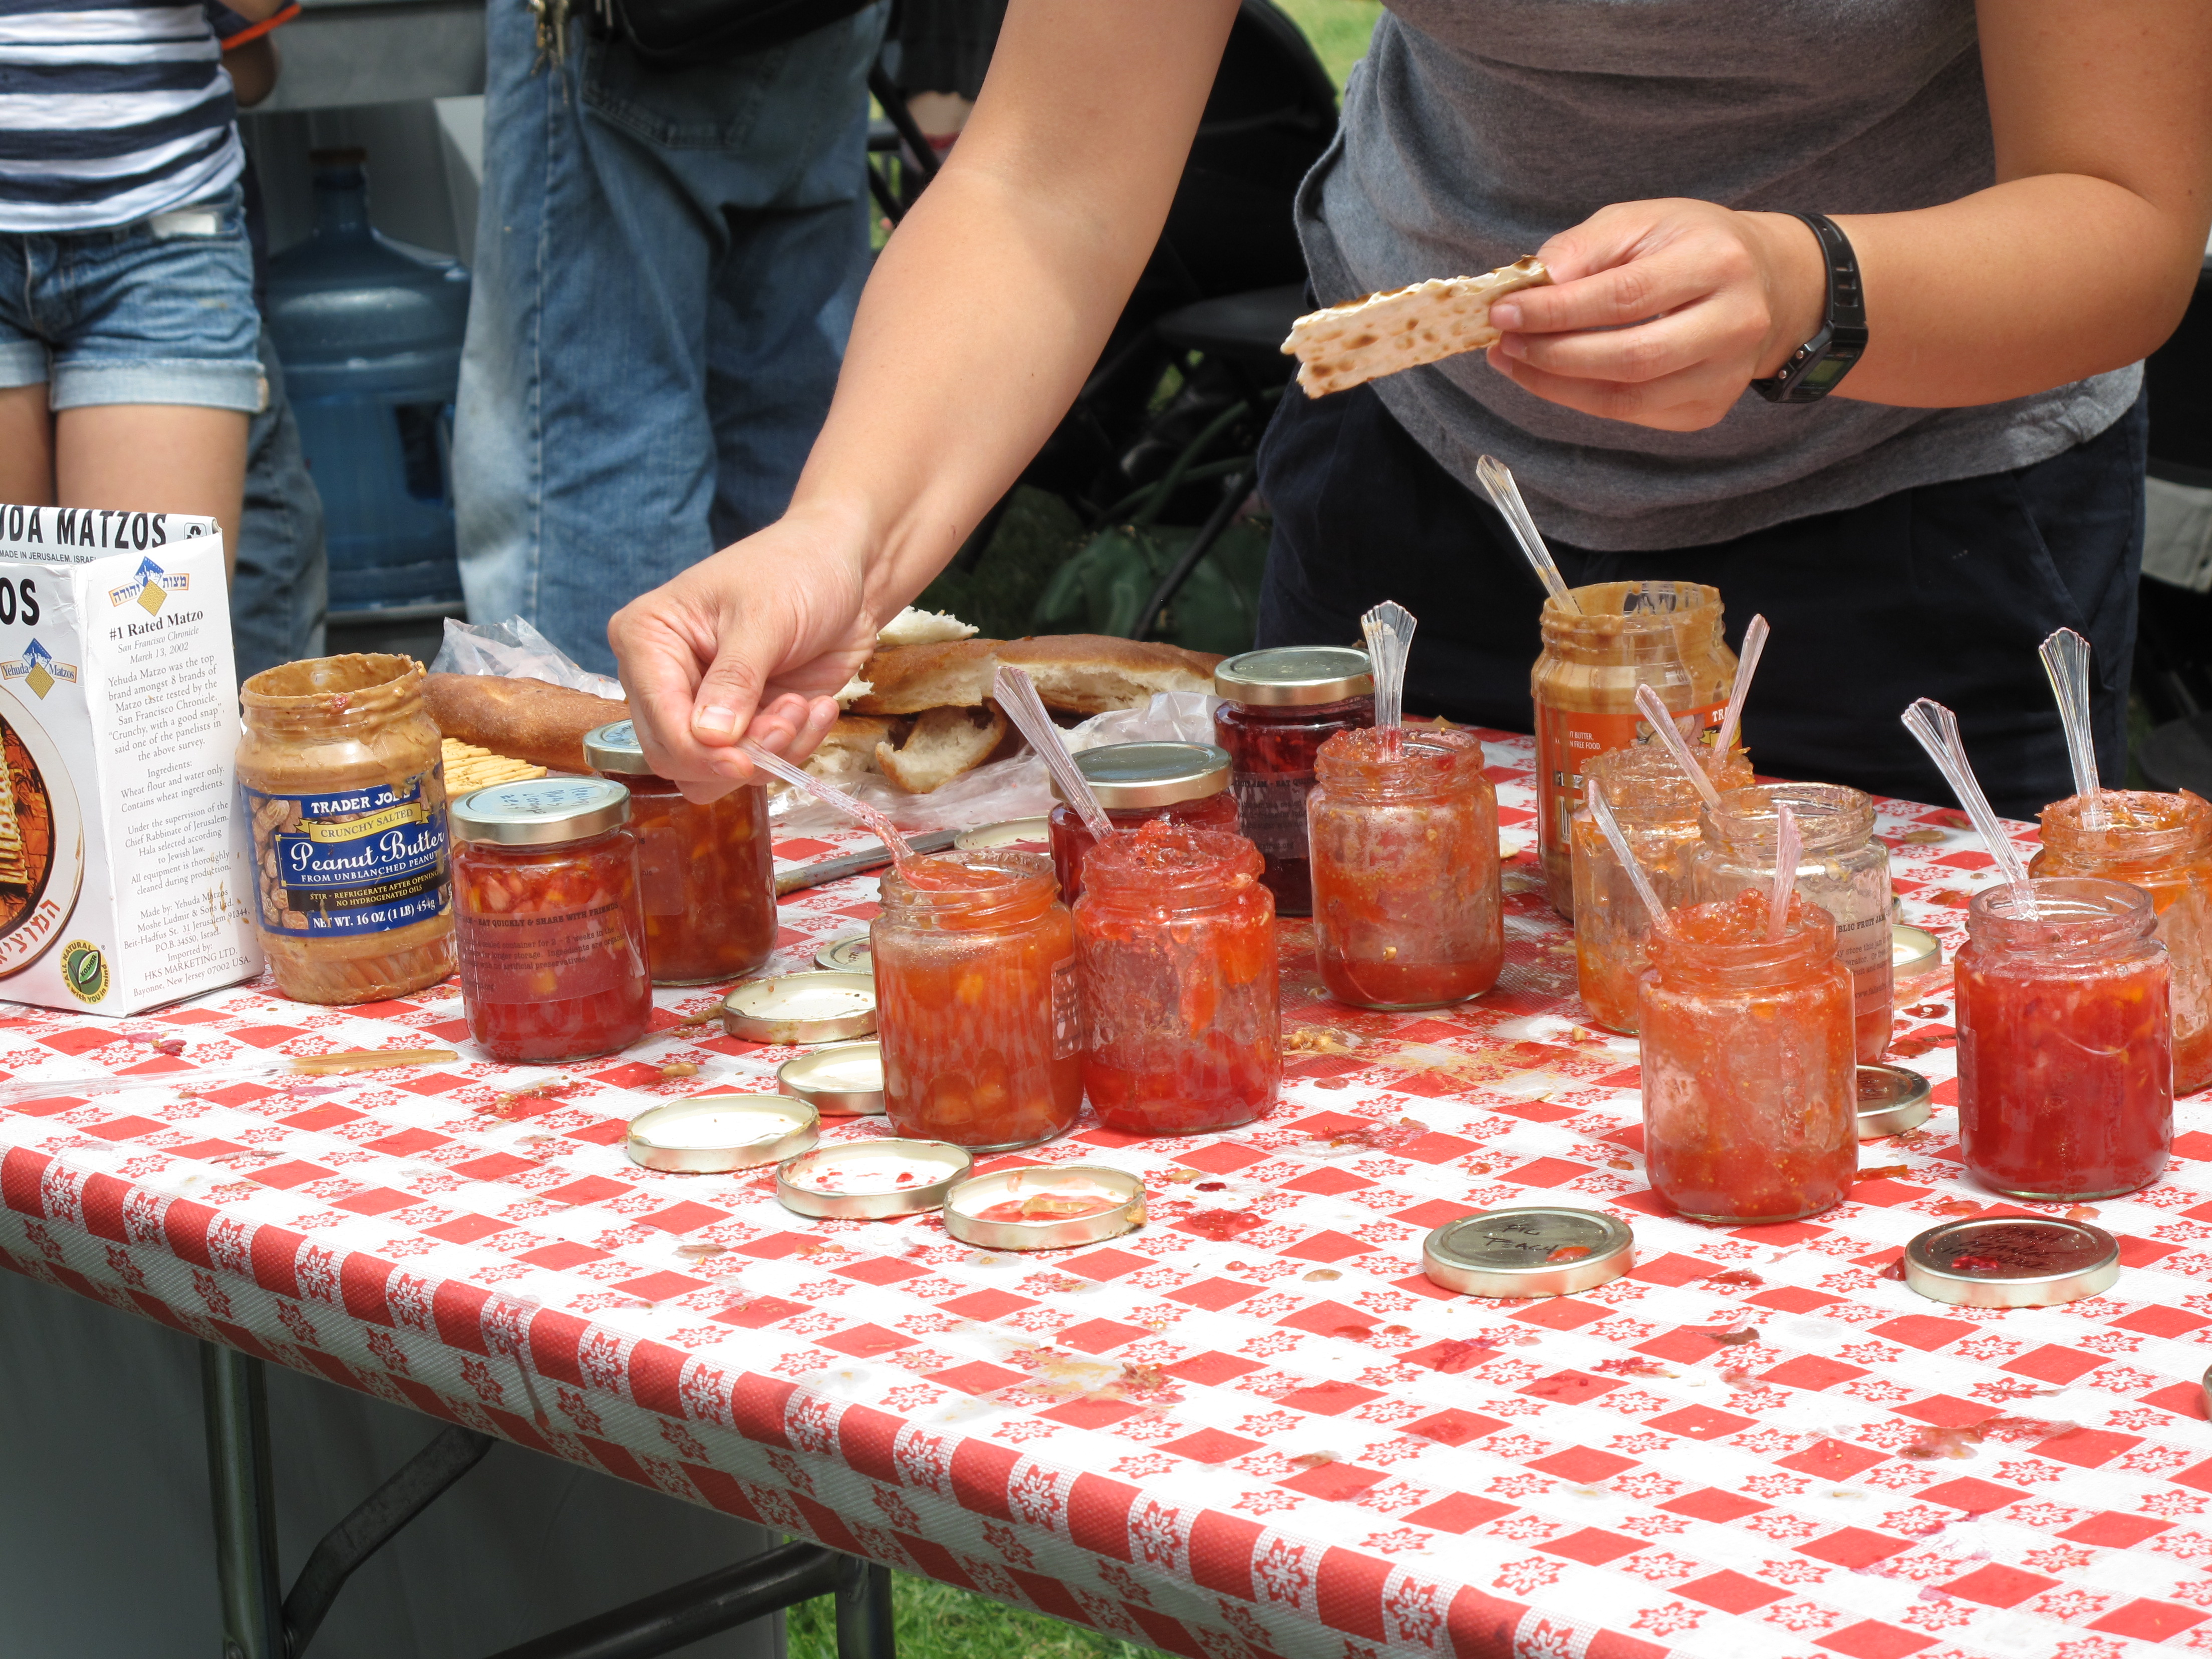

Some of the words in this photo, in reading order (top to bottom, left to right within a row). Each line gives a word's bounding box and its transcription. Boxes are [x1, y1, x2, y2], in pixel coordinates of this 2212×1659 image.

[57, 507, 167, 550] MATZOS
[0, 549, 19, 559] MADE
[20, 551, 27, 559] IN
[74, 555, 96, 564] ISRAE
[112, 584, 140, 604] יהודה
[162, 575, 187, 589] מצות
[109, 627, 124, 642] #1
[127, 617, 163, 638] Rated
[166, 610, 204, 628] Matzo
[118, 644, 132, 653] San
[134, 636, 166, 650] Francisco
[167, 626, 199, 641] Chronicle
[130, 651, 153, 664] March
[155, 647, 167, 658] 13,
[169, 641, 189, 655] 2002
[3, 663, 30, 677] Yehuda
[49, 663, 75, 679] Matzos
[108, 672, 138, 687] Yehuda
[140, 668, 167, 680] Matzo
[169, 663, 184, 672] was
[186, 657, 198, 668] the
[201, 655, 215, 666] top
[108, 686, 132, 701] brand
[134, 680, 169, 692] amongst
[171, 675, 177, 685] 8
[179, 668, 206, 683] brands
[208, 663, 218, 675] of
[115, 700, 142, 713] Matzo
[145, 695, 164, 706] taste
[166, 684, 191, 700] tested
[192, 683, 203, 696] by
[205, 679, 218, 690] the
[118, 715, 133, 726] San
[135, 706, 174, 722] Francisco
[176, 692, 218, 711] Chronicle.
[150, 717, 169, 731] with
[177, 709, 198, 727] good
[114, 740, 130, 755] said
[132, 739, 147, 750] one
[149, 732, 159, 744] of
[161, 731, 174, 742] the
[176, 723, 211, 741] panelists
[213, 718, 222, 728] in
[138, 750, 151, 761] the
[153, 745, 176, 758] above
[178, 738, 206, 751] survey.
[1574, 740, 1585, 749] FREE
[121, 786, 145, 799] Wheat
[147, 781, 166, 792] flour
[168, 774, 183, 786] and
[184, 770, 205, 782] water
[207, 764, 225, 777] only.
[147, 760, 193, 778] Ingredients:
[121, 798, 155, 812] Contains
[157, 791, 179, 803] wheat
[181, 780, 225, 798] ingredients.
[311, 796, 372, 814] TRADER
[125, 834, 145, 848] Chief
[146, 828, 182, 843] Rabbinate
[184, 821, 192, 832] of
[193, 814, 229, 832] Jerusalem.
[128, 822, 150, 835] Under
[152, 818, 164, 829] the
[165, 808, 206, 826] supervision
[207, 802, 216, 813] of
[217, 801, 229, 811] the
[321, 820, 374, 838] CRUNCHY
[377, 808, 413, 825] SALTED
[139, 845, 156, 857] Hala
[158, 836, 186, 852] selected
[188, 828, 222, 844] according
[158, 857, 166, 865] to
[168, 849, 191, 864] Jewish
[193, 846, 205, 855] law.
[291, 842, 379, 871] Peanut
[379, 830, 445, 863] Butter
[131, 874, 141, 885] All
[143, 864, 181, 882] equipment
[183, 862, 189, 870] is
[191, 850, 230, 868] thoroughly
[137, 881, 163, 896] cleaned
[165, 873, 189, 887] during
[190, 865, 231, 884] production.
[301, 874, 331, 883] FROM
[334, 863, 406, 882] UNBLANCHED
[409, 850, 439, 868] PEANUT
[310, 892, 328, 901] STIR
[334, 887, 388, 899] REFRIGERATE
[389, 880, 411, 892] AFTER
[412, 871, 439, 887] OPENING
[336, 899, 349, 907] NO
[350, 889, 409, 906] HYDROGENATED
[409, 884, 423, 895] OILS
[137, 919, 162, 933] Moshe
[163, 912, 190, 925] Ludmir
[192, 909, 199, 917] &
[200, 905, 217, 915] Sons
[140, 907, 161, 920] Made
[163, 904, 173, 915] by:
[174, 896, 200, 910] Yehuda
[202, 890, 229, 902] Matzos
[313, 917, 333, 929] NET
[334, 915, 354, 928] WT.
[356, 914, 369, 925] 16
[371, 911, 386, 924] OZ
[388, 908, 398, 922] (1
[400, 905, 415, 918] LB)
[416, 899, 436, 912] 454g
[492, 919, 524, 928] QUICKLY
[536, 916, 564, 925] SHARE
[567, 912, 587, 921] WITH
[589, 902, 619, 917] FRIENDS
[124, 931, 167, 950] Beit-Hadfus
[169, 928, 179, 937] St.
[192, 915, 226, 930] Jerusalem
[177, 935, 199, 947] 34550,
[200, 929, 221, 940] Israel.
[574, 932, 595, 942] weeks
[1837, 923, 1855, 933] BLIC
[1856, 918, 1875, 929] FRUIT
[62, 942, 92, 961] NATURAL
[167, 947, 201, 962] Imported
[547, 945, 590, 957] Ingredients
[604, 934, 626, 946] organic
[80, 954, 97, 978] KOSHER
[133, 982, 165, 998] Bayonne,
[166, 977, 184, 988] New
[185, 969, 206, 984] Jersey
[207, 962, 231, 975] 07002
[232, 956, 251, 967] USA.
[144, 968, 163, 981] HKS
[164, 952, 217, 975] MARKETING
[219, 947, 238, 959] LTD.
[87, 994, 101, 1003] YOU
